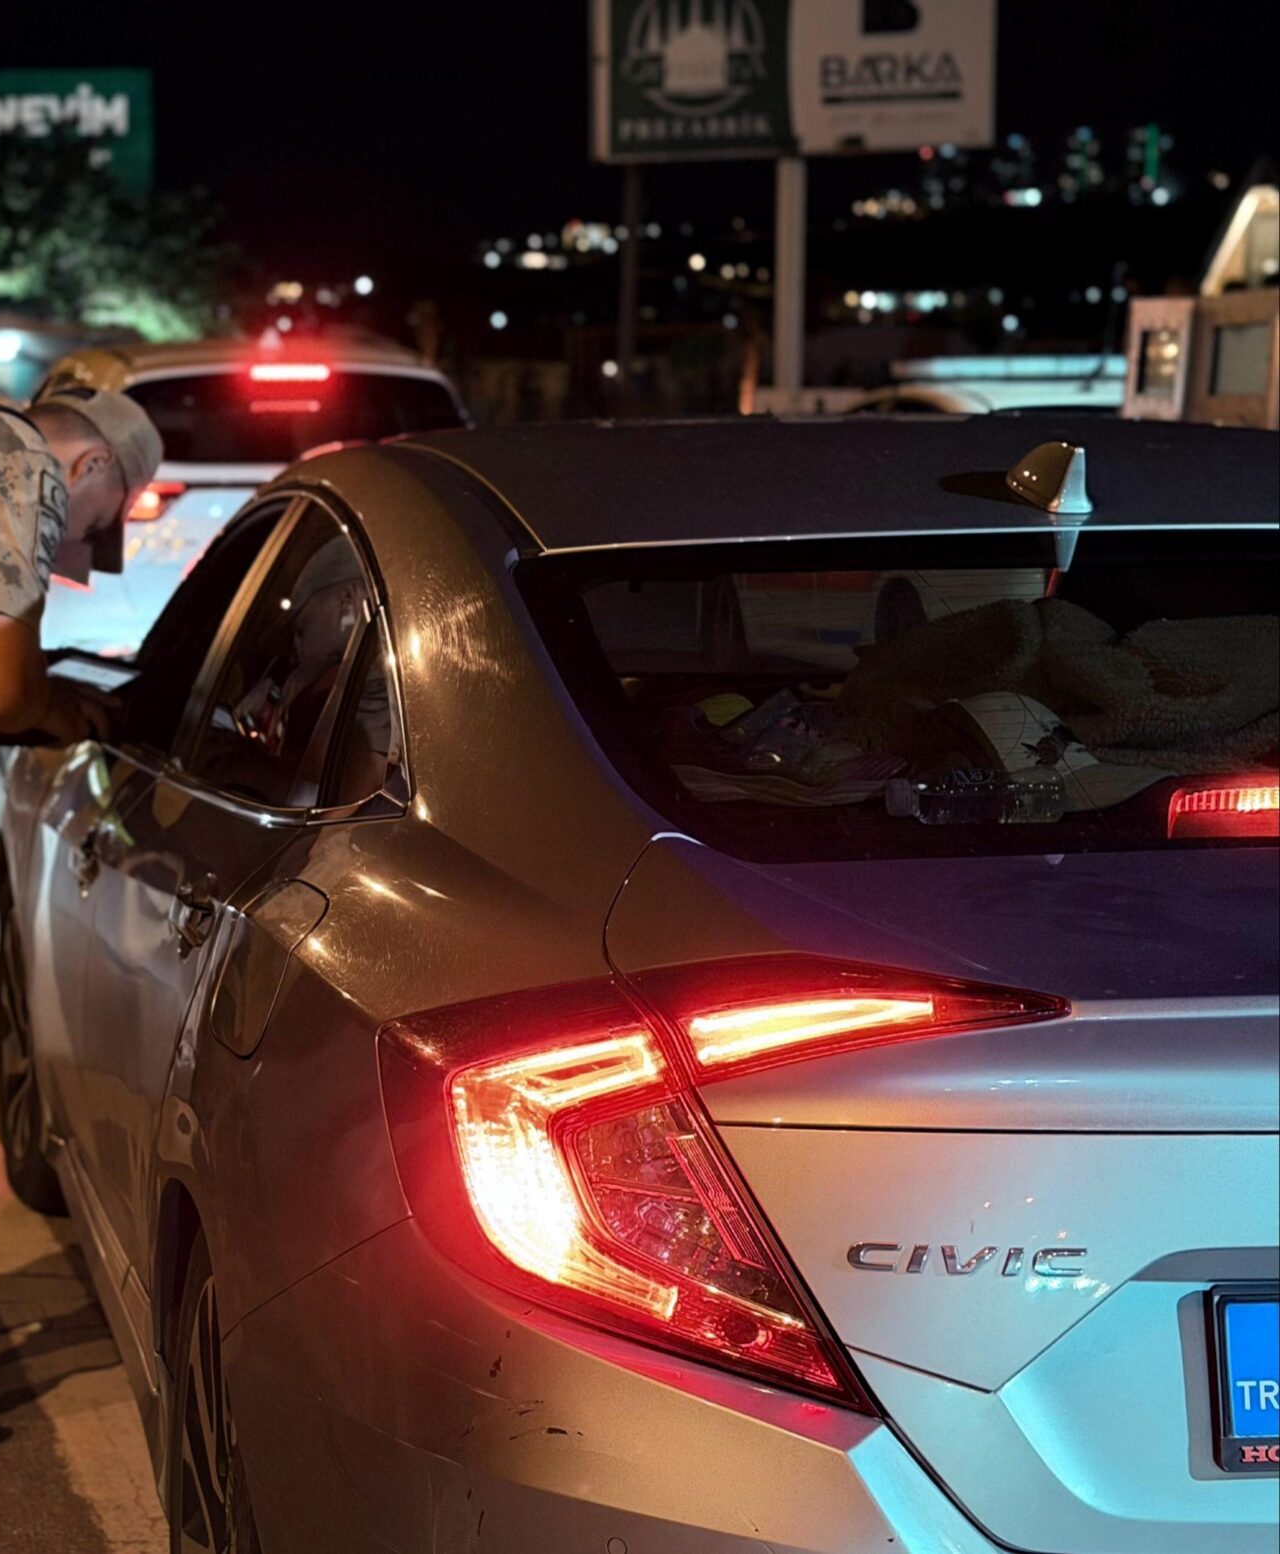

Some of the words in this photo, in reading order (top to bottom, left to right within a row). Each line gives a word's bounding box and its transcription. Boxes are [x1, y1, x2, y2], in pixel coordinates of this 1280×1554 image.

[821, 51, 961, 89] BARKA
[846, 1242, 1088, 1277] CIVIC
[1235, 1379, 1279, 1411] TR
